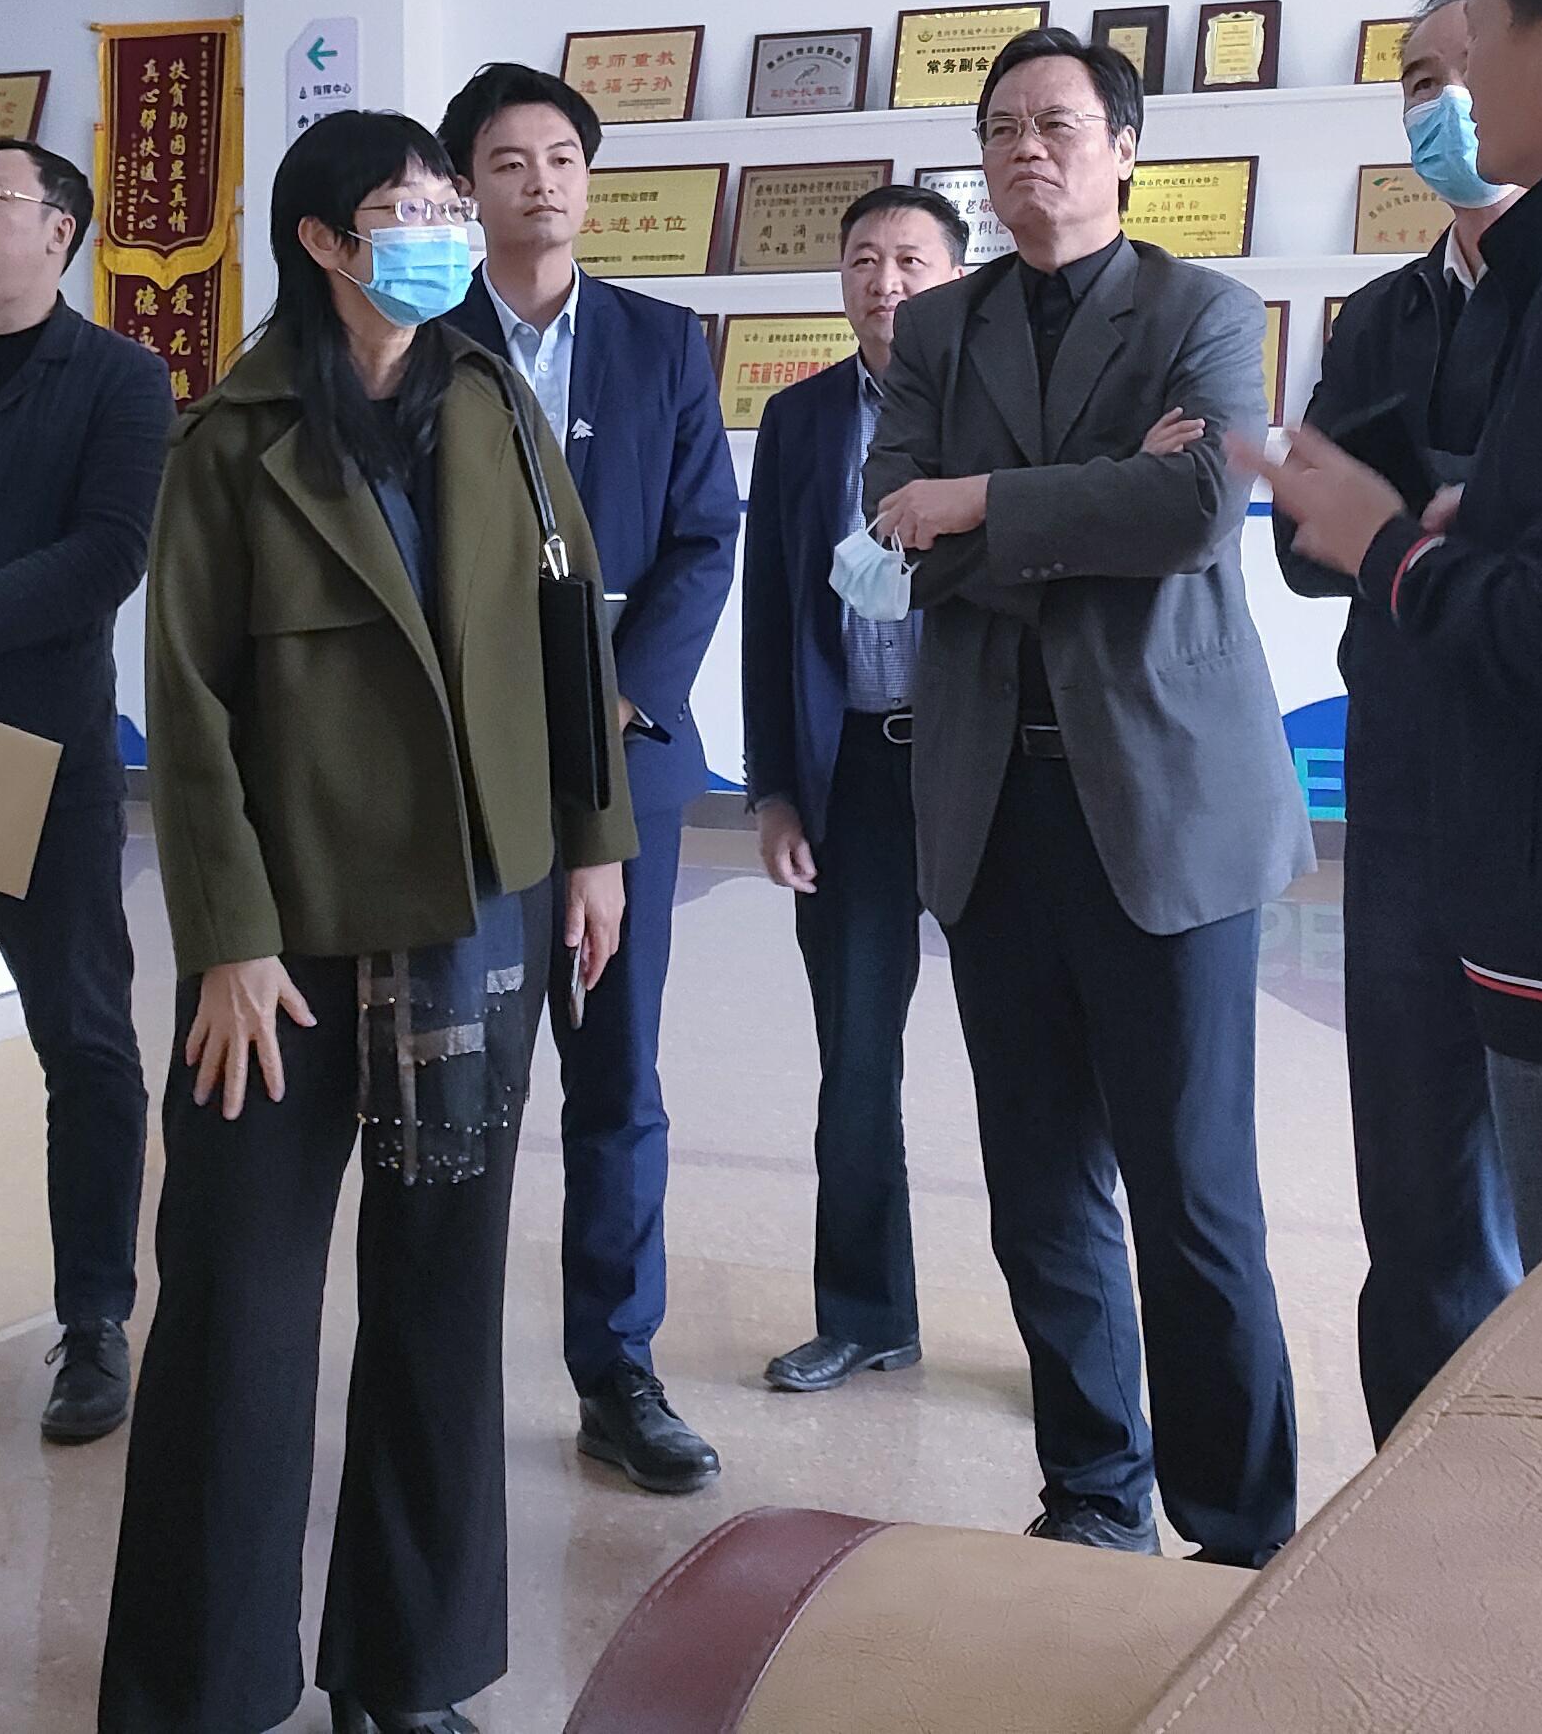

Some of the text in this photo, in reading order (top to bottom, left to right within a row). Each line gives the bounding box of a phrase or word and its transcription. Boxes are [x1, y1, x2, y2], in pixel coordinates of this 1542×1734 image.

[583, 50, 676, 70] 尊师重教
[312, 83, 352, 97] 指挥中心
[579, 76, 673, 95] 造福子孙
